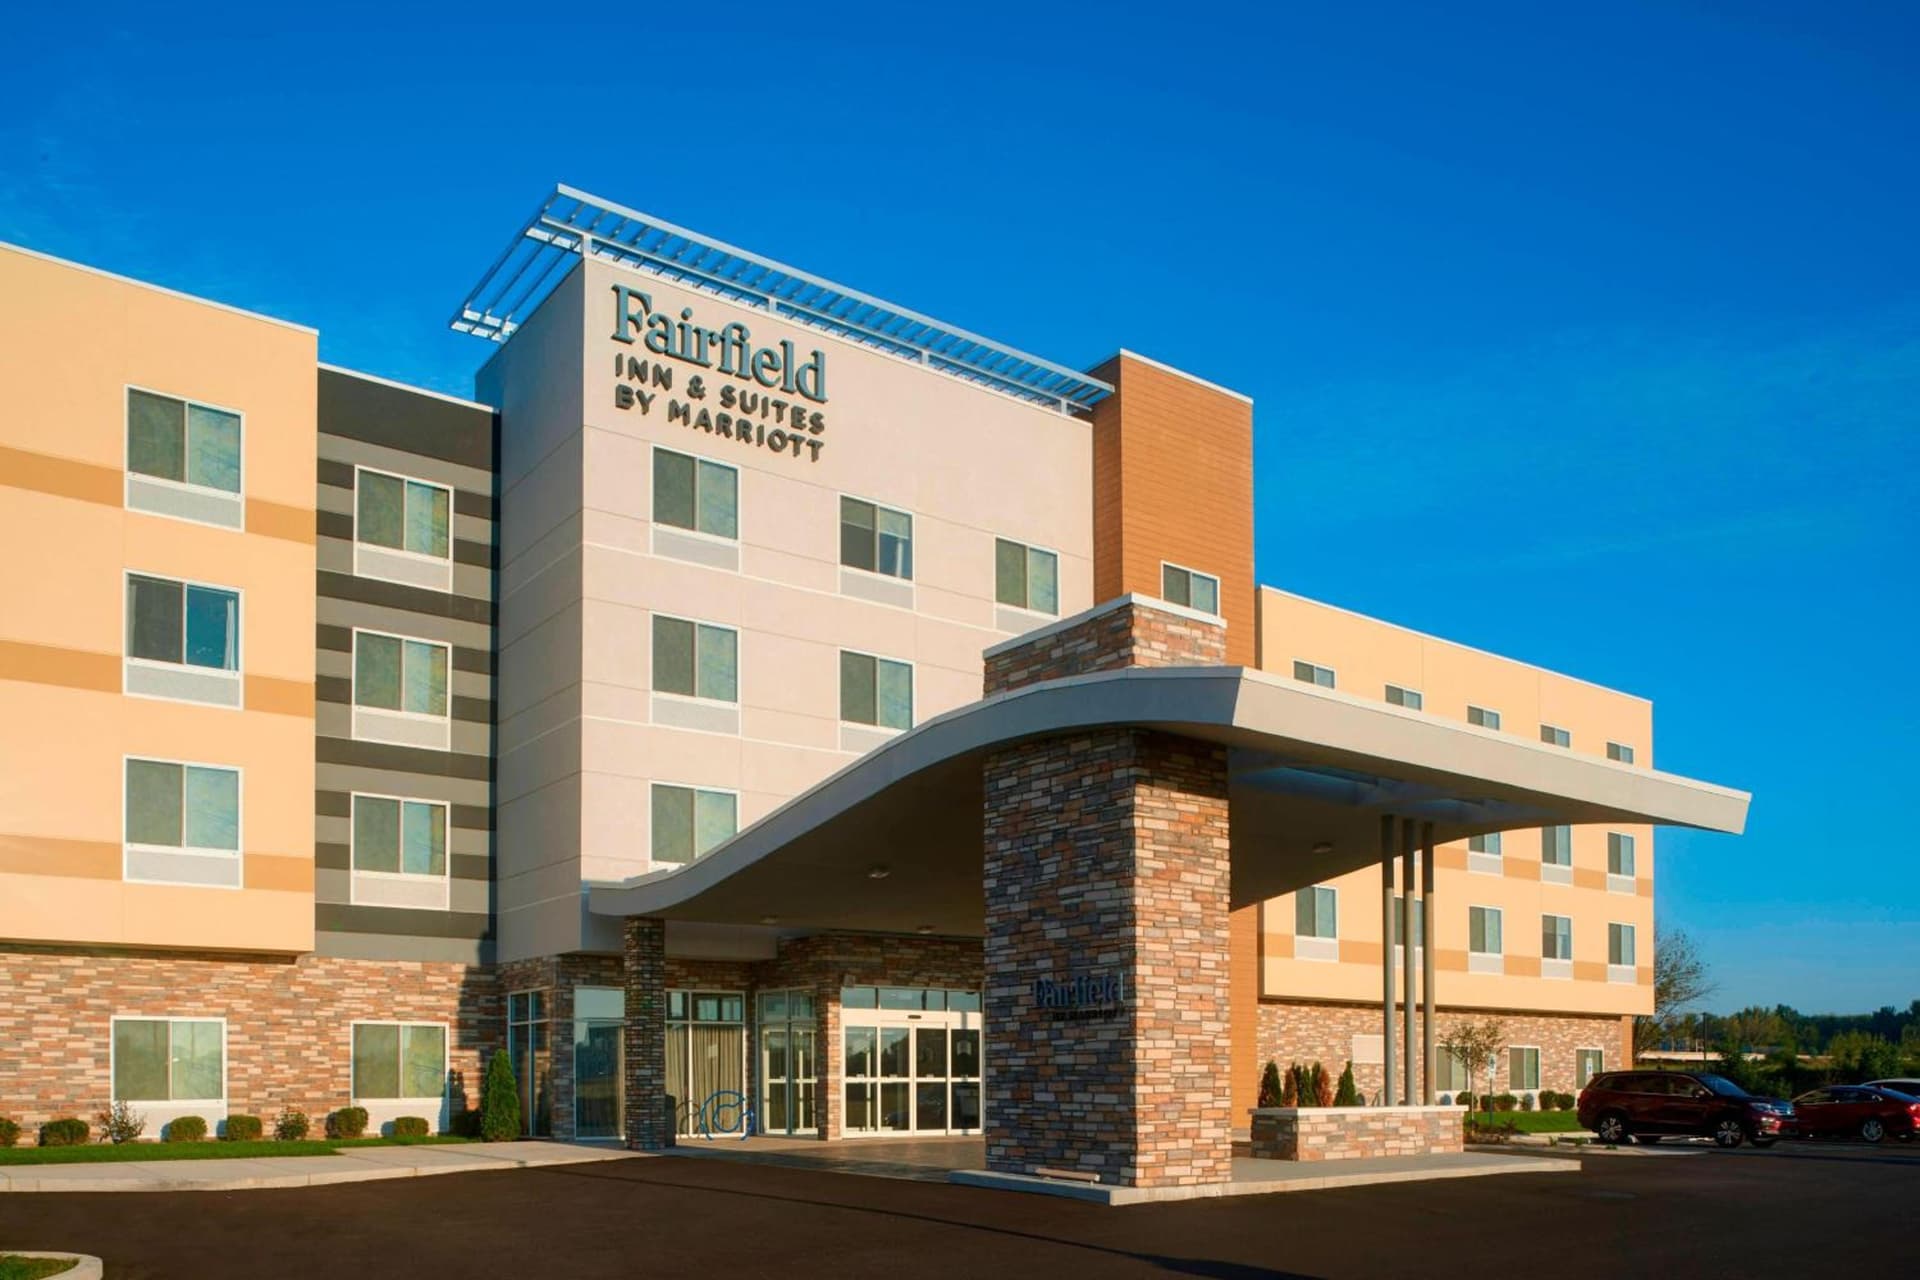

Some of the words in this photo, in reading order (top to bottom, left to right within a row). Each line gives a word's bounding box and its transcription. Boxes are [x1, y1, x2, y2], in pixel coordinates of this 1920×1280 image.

[611, 283, 828, 403] Fairfield
[615, 352, 673, 391] INN
[686, 374, 706, 401] &
[720, 384, 825, 435] SUITES
[615, 383, 656, 415] BY
[668, 398, 825, 463] MARRIOTT
